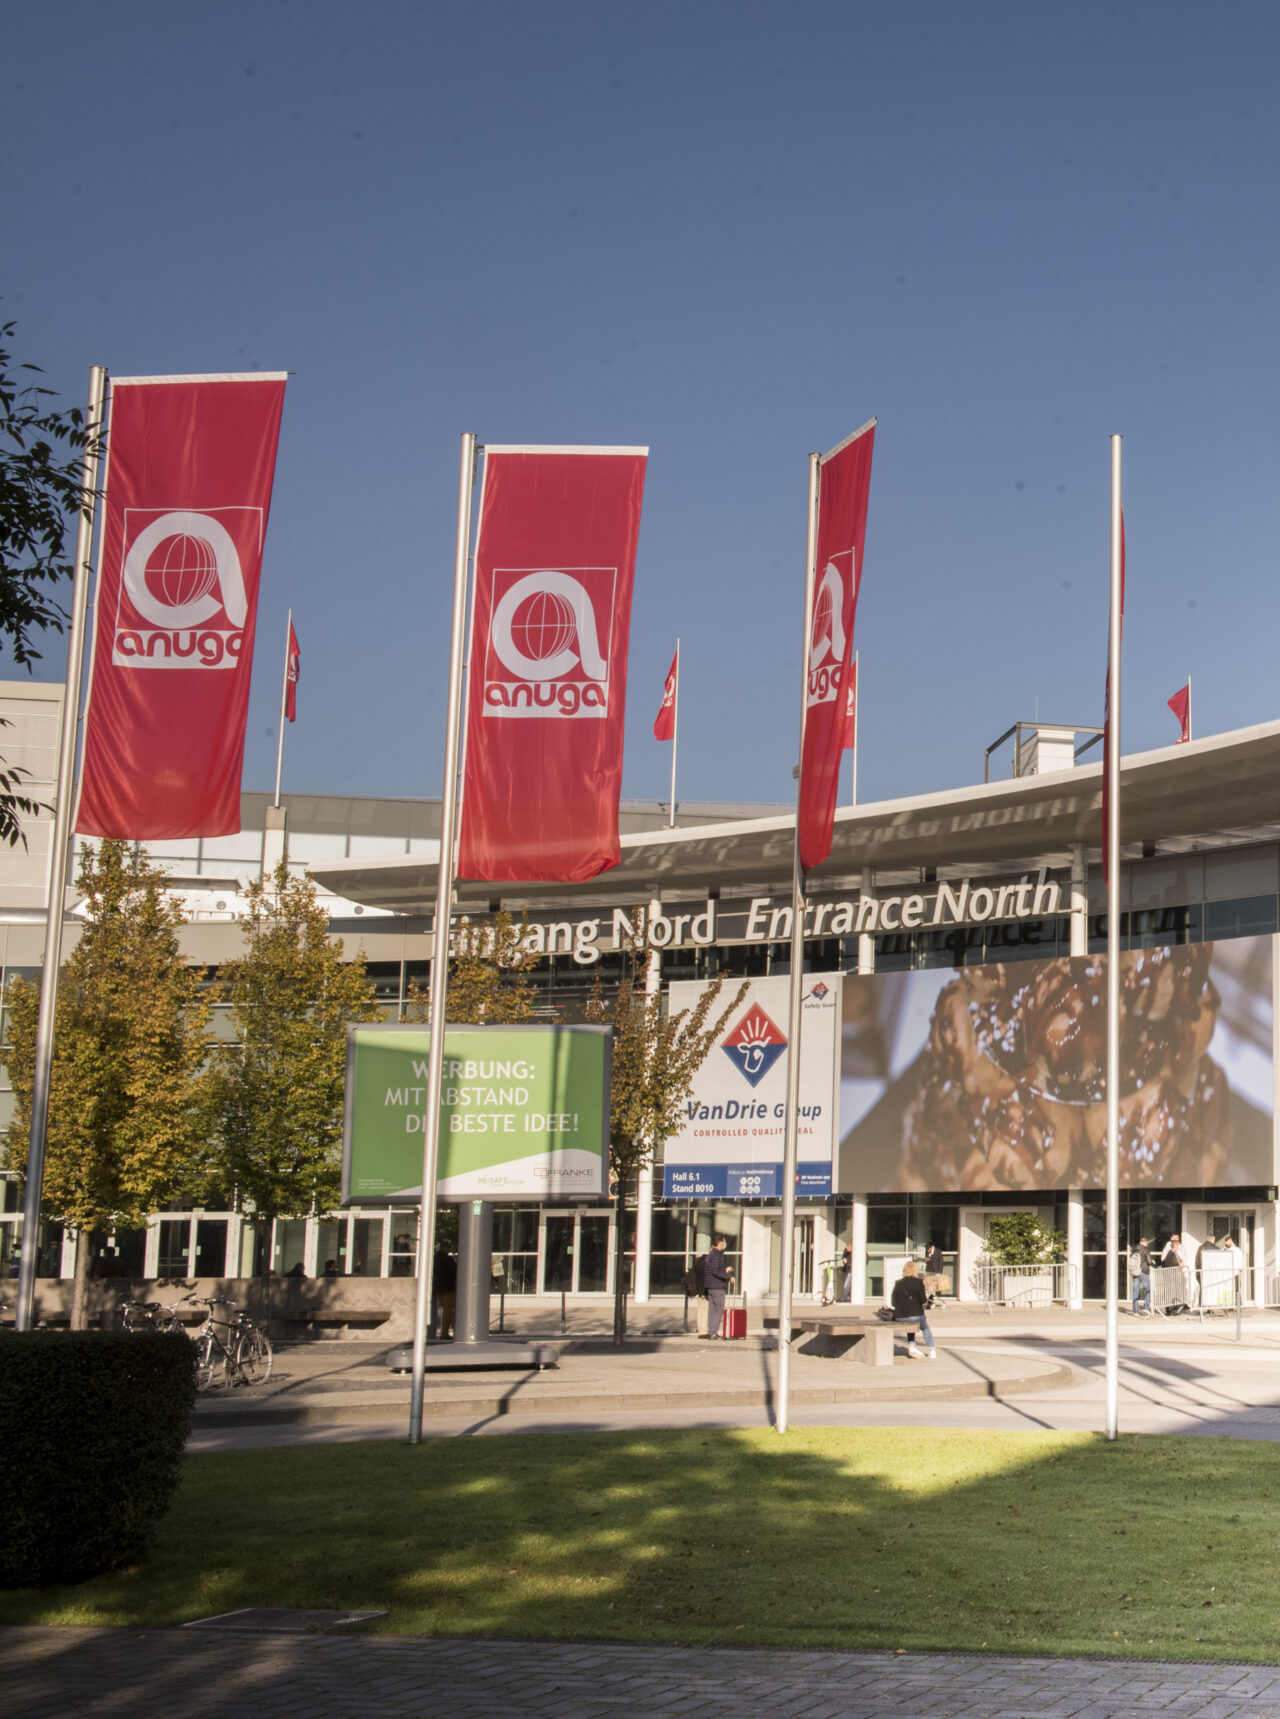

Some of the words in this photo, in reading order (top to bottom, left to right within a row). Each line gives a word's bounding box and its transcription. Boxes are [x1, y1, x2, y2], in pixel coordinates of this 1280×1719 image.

[485, 683, 606, 716] anuga
[745, 894, 925, 941] Entrance
[932, 867, 1062, 924] North
[612, 899, 716, 950] Nord
[384, 1087, 426, 1107] MIT
[687, 1099, 768, 1121] VanDrie
[405, 1114, 427, 1134] DI
[451, 1113, 516, 1133] BESTE
[525, 1113, 580, 1133] IDEE!
[693, 1128, 748, 1137] CONTROLLED
[797, 1127, 814, 1135] EAL
[672, 1172, 688, 1181] Hall
[688, 1172, 700, 1181] 6.1
[672, 1183, 694, 1193] Stand
[695, 1183, 714, 1193] B010
